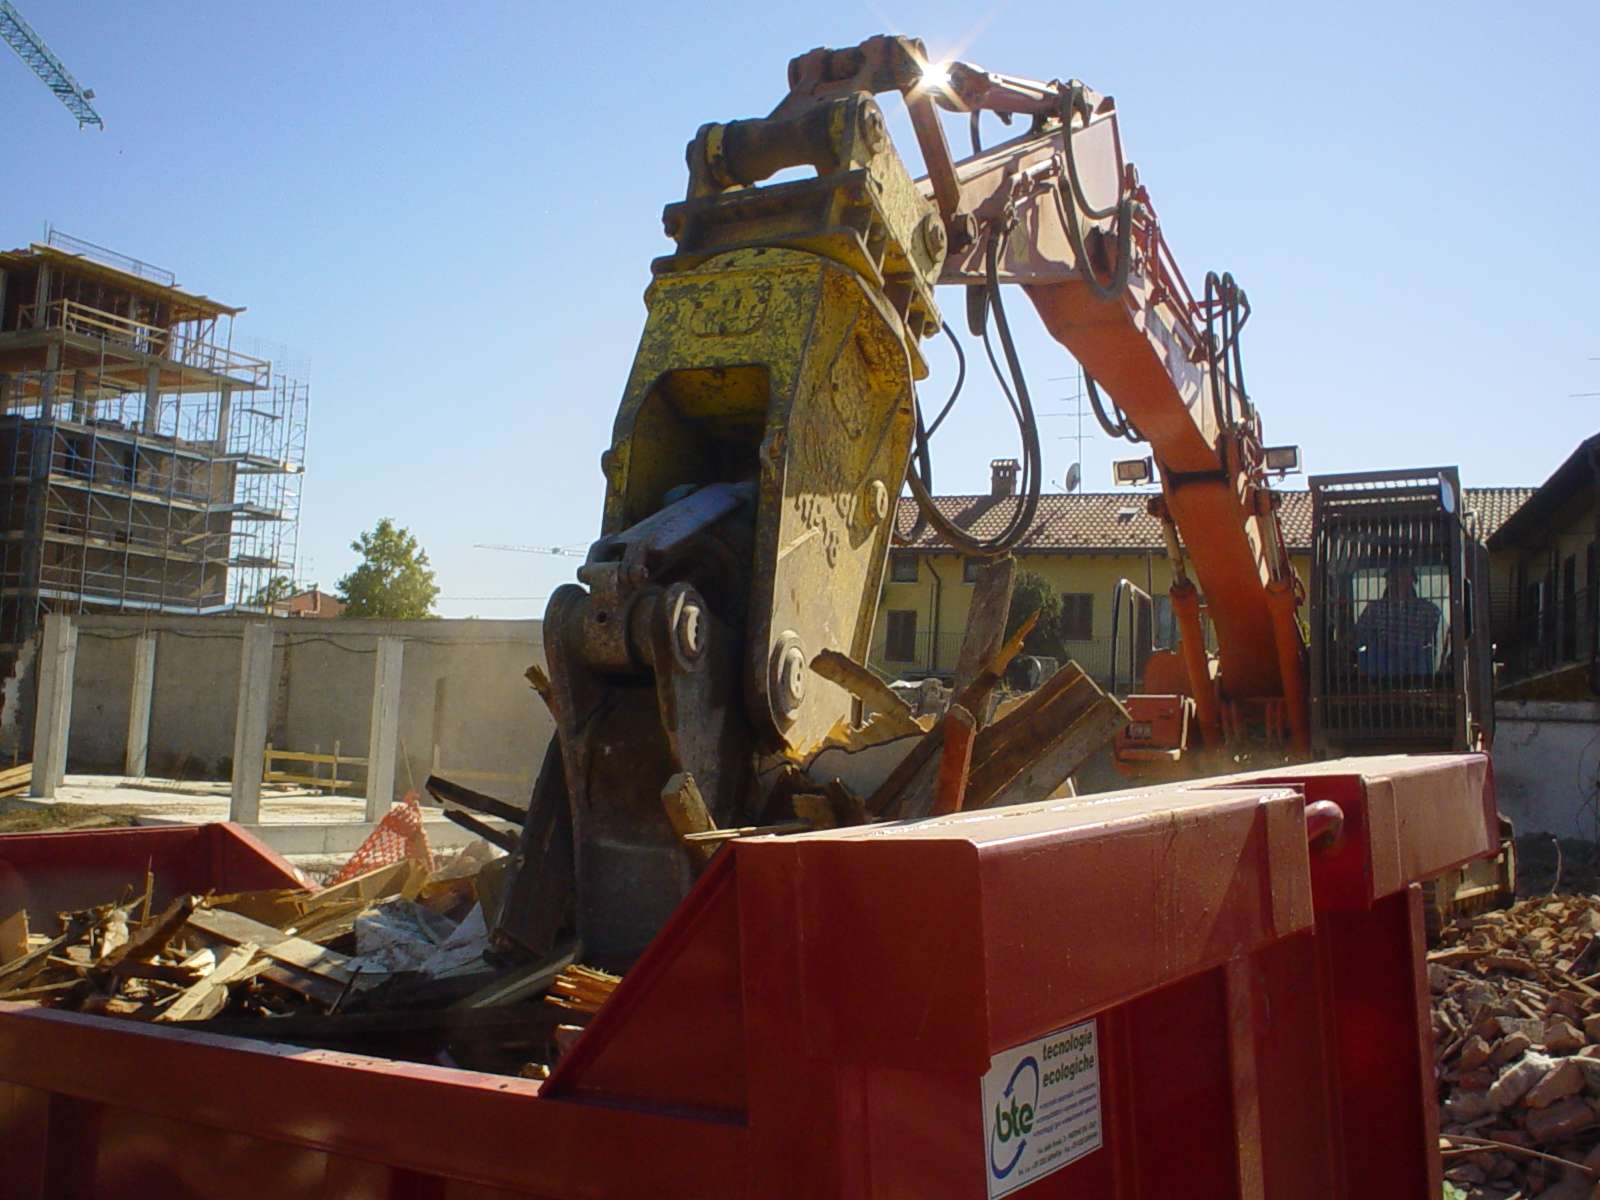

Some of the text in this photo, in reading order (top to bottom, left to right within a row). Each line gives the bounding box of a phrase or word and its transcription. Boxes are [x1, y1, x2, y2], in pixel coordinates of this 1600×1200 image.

[1043, 1029, 1093, 1061] tecnologie
[1043, 1053, 1095, 1087] ecologiche
[995, 1096, 1034, 1143] bte
